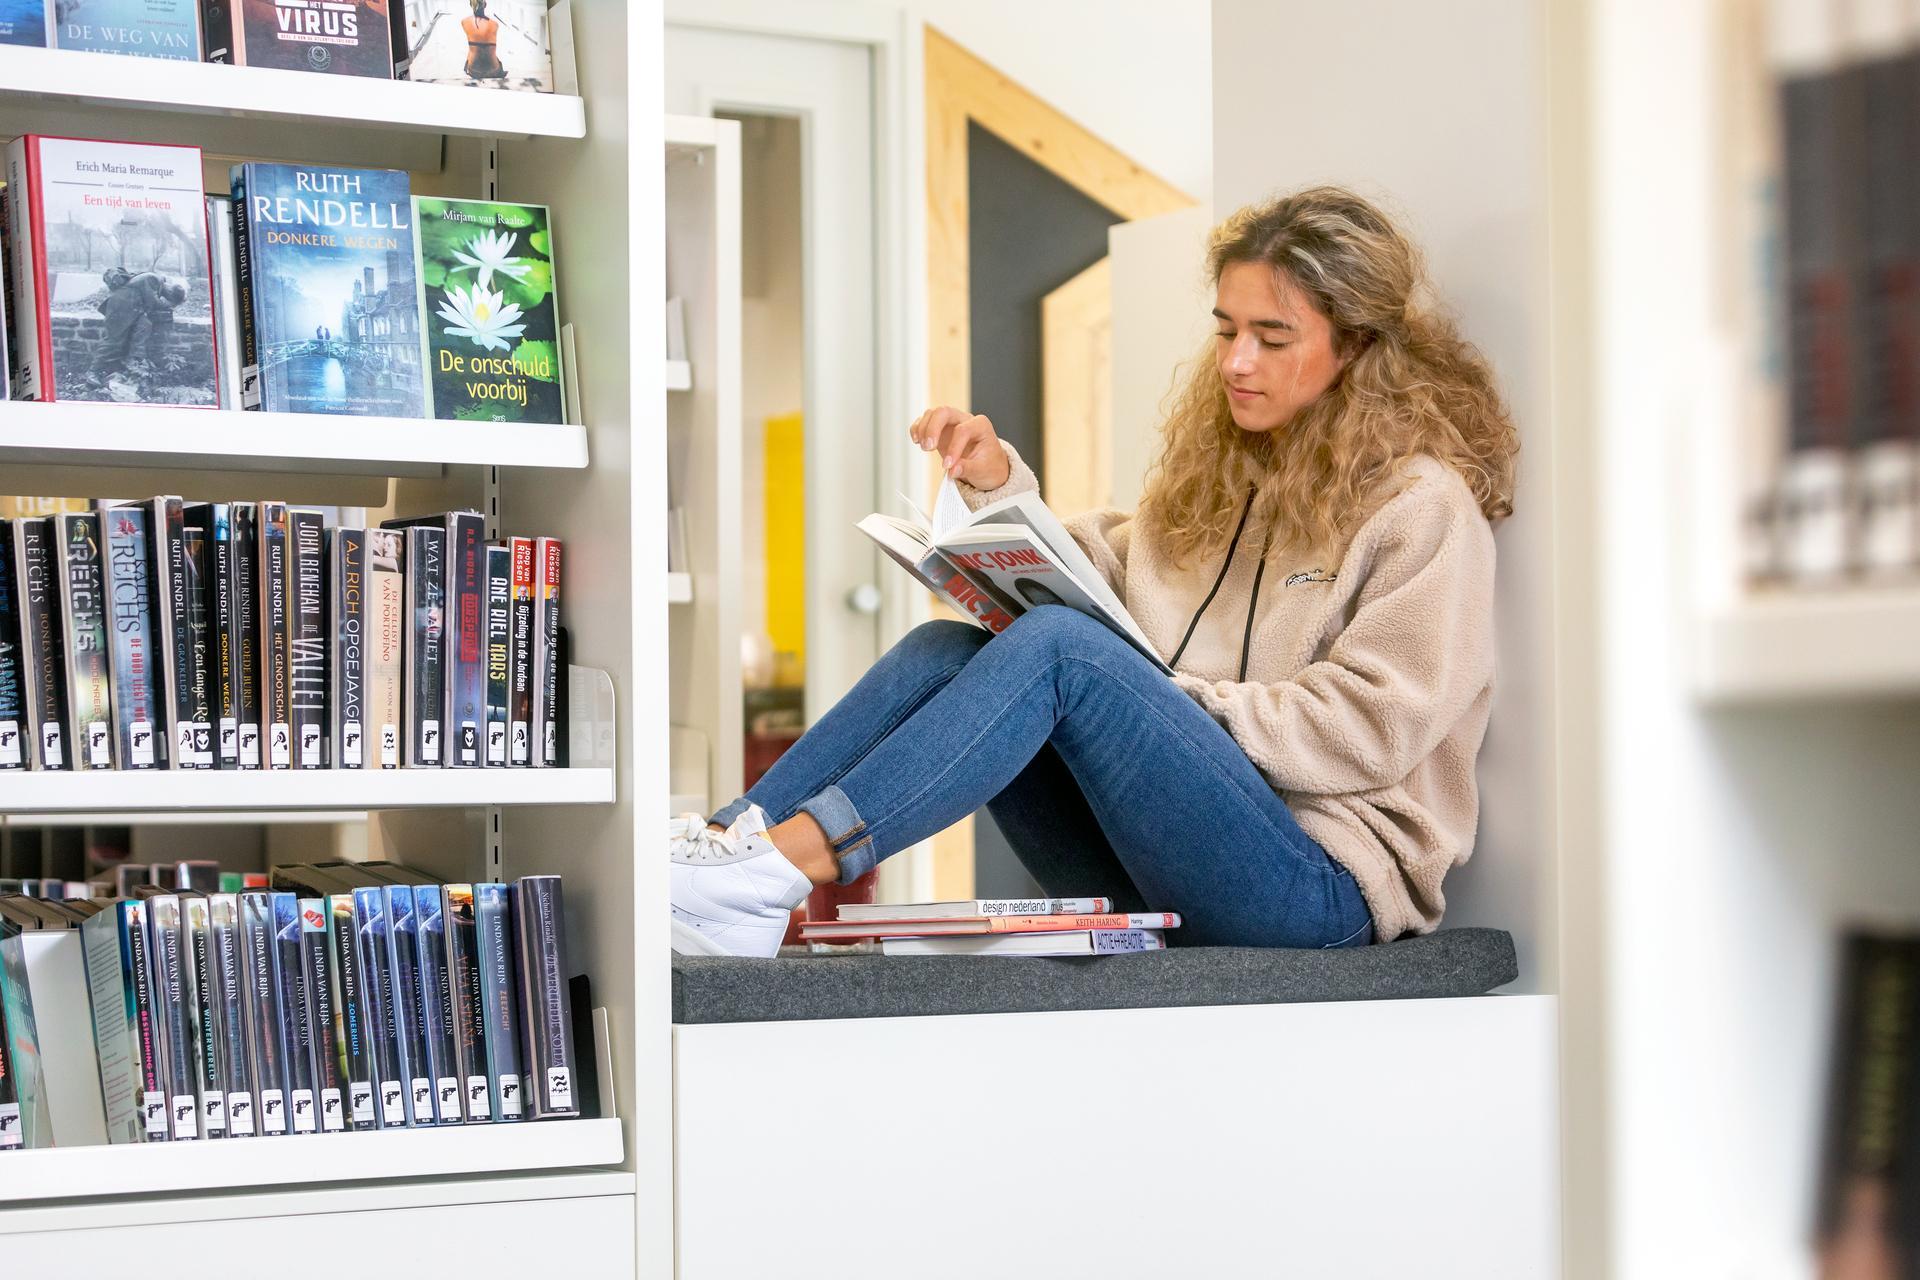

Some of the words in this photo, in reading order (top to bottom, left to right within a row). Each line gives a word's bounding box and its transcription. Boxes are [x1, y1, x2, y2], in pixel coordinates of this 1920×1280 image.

[67, 24, 94, 40] DE
[101, 27, 143, 45] WEG
[150, 31, 189, 48] VAN
[275, 7, 358, 37] VIRUS
[76, 161, 100, 172] Erich
[102, 163, 127, 174] Maria
[129, 165, 174, 179] Remarque
[295, 171, 361, 195] RUTH
[84, 194, 103, 206] Een
[105, 196, 122, 209] tijd
[125, 199, 142, 209] van
[145, 197, 171, 210] leven
[253, 196, 409, 230] RENDELL
[236, 203, 245, 231] RUTH
[443, 210, 477, 224] Mirjam
[478, 215, 495, 224] van
[497, 214, 525, 226] Raalte
[266, 231, 337, 248] DONKERE
[344, 234, 397, 250] WEGEN
[239, 234, 248, 282] RENDELL
[242, 287, 250, 330] DONKERE
[440, 349, 465, 373] De
[471, 354, 550, 378] onschuld
[466, 379, 527, 406] voorbij
[299, 522, 319, 555] JOHN
[171, 538, 182, 568] RUTH
[218, 544, 226, 573] RUTH
[271, 545, 281, 573] RUTH
[346, 540, 359, 566] A.J.
[427, 540, 439, 575] WAT
[516, 545, 525, 581] Riessen
[523, 546, 532, 565] Joop
[548, 546, 556, 582] Riessen
[985, 548, 1049, 572] JONK
[26, 534, 45, 604] REICHS
[240, 556, 249, 583] RUTH
[69, 543, 97, 652] REICHS
[91, 564, 103, 630] KATHY
[111, 543, 141, 634] REICHS
[134, 559, 150, 616] KATHY
[174, 572, 186, 621] RENDELL
[300, 559, 320, 614] RENEHAN
[346, 572, 360, 614] RICH
[382, 578, 391, 600] VAN
[391, 590, 399, 603] DE
[427, 581, 439, 600] ZE
[490, 576, 507, 603] ANE
[943, 572, 990, 614] NIC
[220, 579, 228, 626] RENDELL
[242, 586, 250, 631] RENDELL
[273, 578, 283, 626] RENDELL
[41, 612, 51, 653] BONES
[176, 627, 187, 640] DE
[302, 624, 318, 635] DE
[382, 604, 391, 662] PORTOFINO
[391, 606, 399, 650] CELLISTE
[427, 606, 439, 664] NALIET
[490, 608, 507, 638] RIEL
[515, 605, 529, 639] Gijzeling
[550, 607, 558, 635] Moord
[221, 633, 229, 677] DONKERE
[243, 638, 252, 673] GOEDE
[275, 633, 283, 650] HET
[517, 640, 527, 648] in
[517, 649, 527, 660] de
[549, 638, 557, 648] op
[550, 650, 557, 661] de
[43, 656, 54, 690] VOOR
[177, 643, 188, 703] GRAFKELDER
[291, 637, 325, 709] VALLEI
[489, 643, 507, 680] HARS
[191, 669, 206, 699] lange
[517, 661, 528, 691] Jordaan
[222, 682, 231, 716] WEGEN
[243, 675, 253, 709] BUREN
[549, 676, 558, 718] tramhalte
[542, 891, 551, 919] Nicholas
[982, 901, 1008, 915] design
[1009, 900, 1046, 913] nederland
[493, 915, 503, 943] LINDA
[1075, 918, 1095, 927] KEITH
[1096, 917, 1122, 926] HARING
[1131, 918, 1143, 926] Haring
[133, 932, 142, 961] LINDA
[166, 929, 176, 959] LINDA
[197, 931, 206, 959] LINDA
[223, 928, 233, 956] LINDA
[255, 926, 264, 954] LINDA
[341, 926, 350, 954] LINDA
[496, 944, 504, 963] VAN
[136, 962, 144, 982] VAN
[169, 960, 178, 980] VAN
[199, 961, 207, 981] VAN
[225, 958, 234, 978] VAN
[257, 955, 266, 975] VAN
[314, 946, 325, 977] LINDA
[344, 956, 352, 975] VAN
[457, 954, 470, 988] VIVA
[497, 964, 506, 984] RIJN
[138, 984, 147, 1004] RIJN
[171, 981, 181, 1002] RIJN
[200, 982, 209, 1003] RIJN
[226, 979, 237, 1000] RIJN
[258, 976, 269, 998] RIJN
[296, 976, 305, 1004] LINDA
[317, 979, 327, 1001] VAN
[345, 976, 355, 997] RIJN
[382, 969, 392, 997] LINDA
[440, 966, 449, 994] LINDA
[471, 967, 480, 995] LINDA
[319, 1003, 330, 1025] RIJN
[385, 998, 394, 1017] VAN
[413, 966, 421, 994] LINDA
[418, 1016, 426, 1035] RIJN
[442, 996, 451, 1014] VAN
[474, 997, 482, 1014] VAN
[500, 990, 510, 1031] ZEEZICHT
[298, 1006, 307, 1025] VAN
[348, 1003, 360, 1056] ZOMERHUIS
[387, 1019, 396, 1038] RIJN
[444, 1016, 454, 1035] RIJN
[475, 1016, 484, 1036] RIJN
[141, 1010, 153, 1069] BESTEMMING
[203, 1008, 215, 1080] WINTERWERELD
[299, 1027, 309, 1046] RIJN
